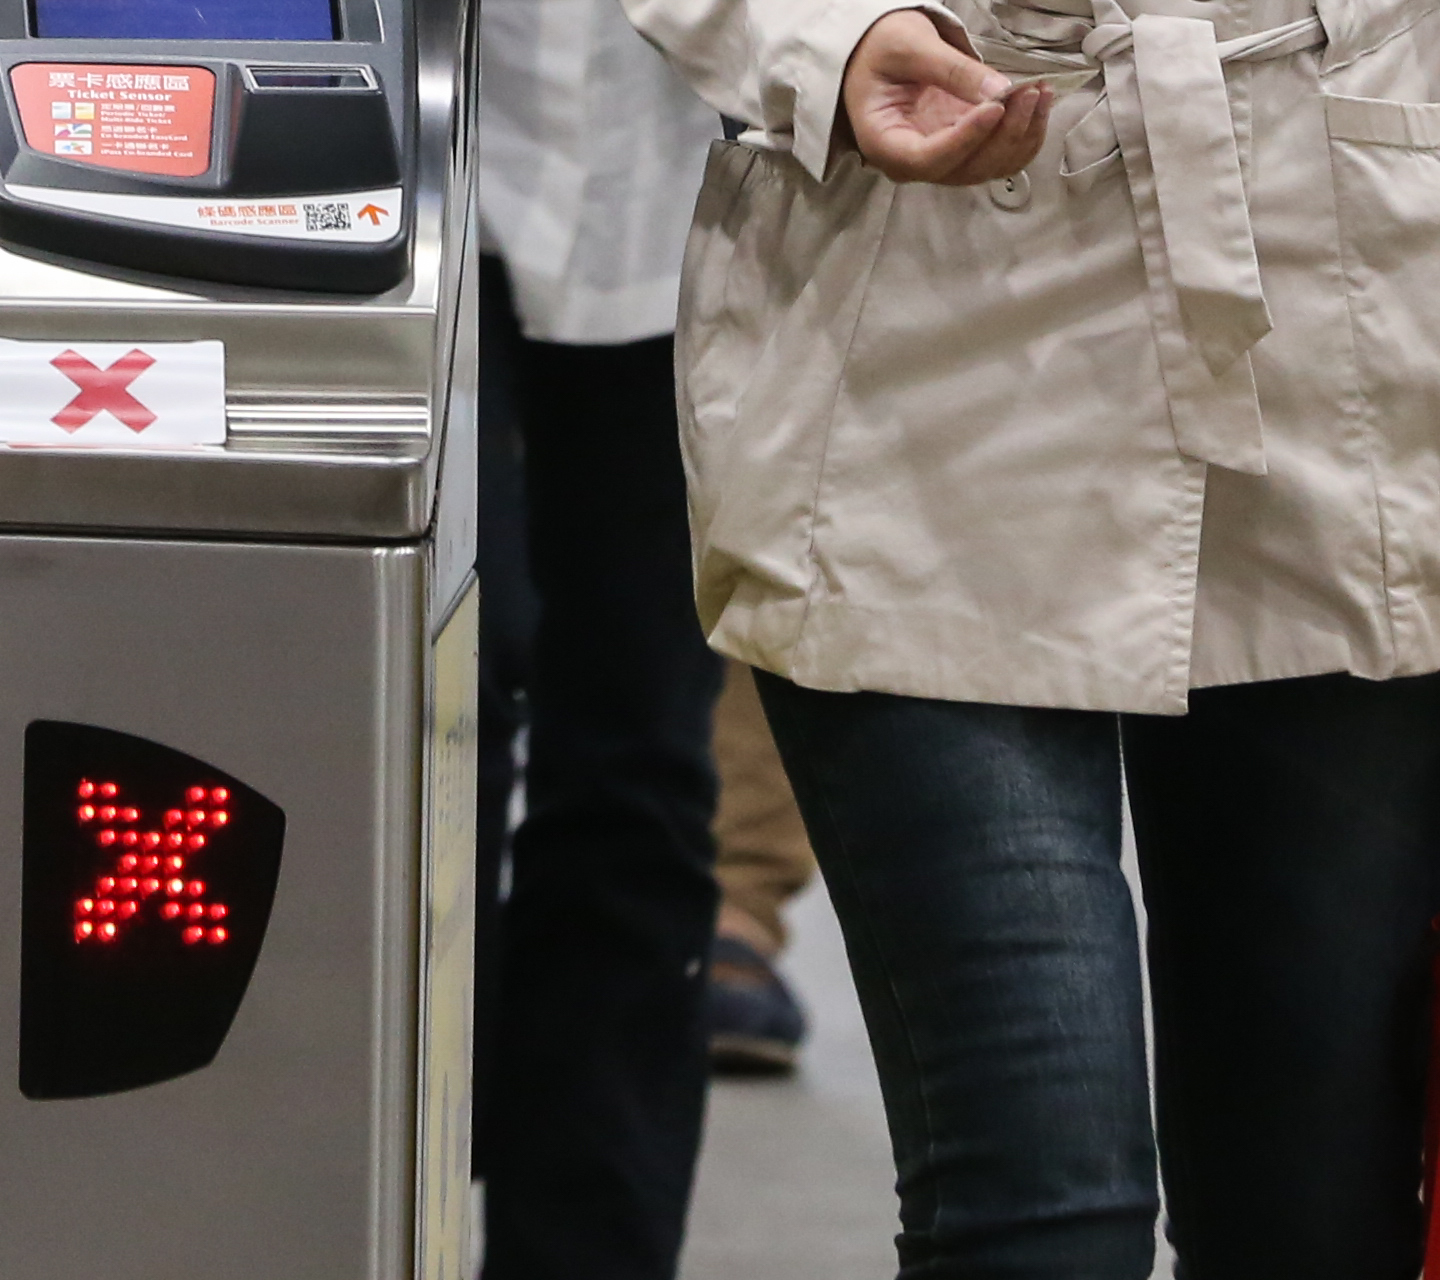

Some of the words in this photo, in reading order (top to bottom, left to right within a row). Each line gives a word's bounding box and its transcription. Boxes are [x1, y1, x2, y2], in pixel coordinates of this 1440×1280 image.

[48, 71, 190, 91] 票卡感應區
[68, 89, 115, 100] Ticket
[120, 91, 172, 102] Sensor
[210, 218, 253, 227] Barcode
[256, 218, 299, 226] Scanner
